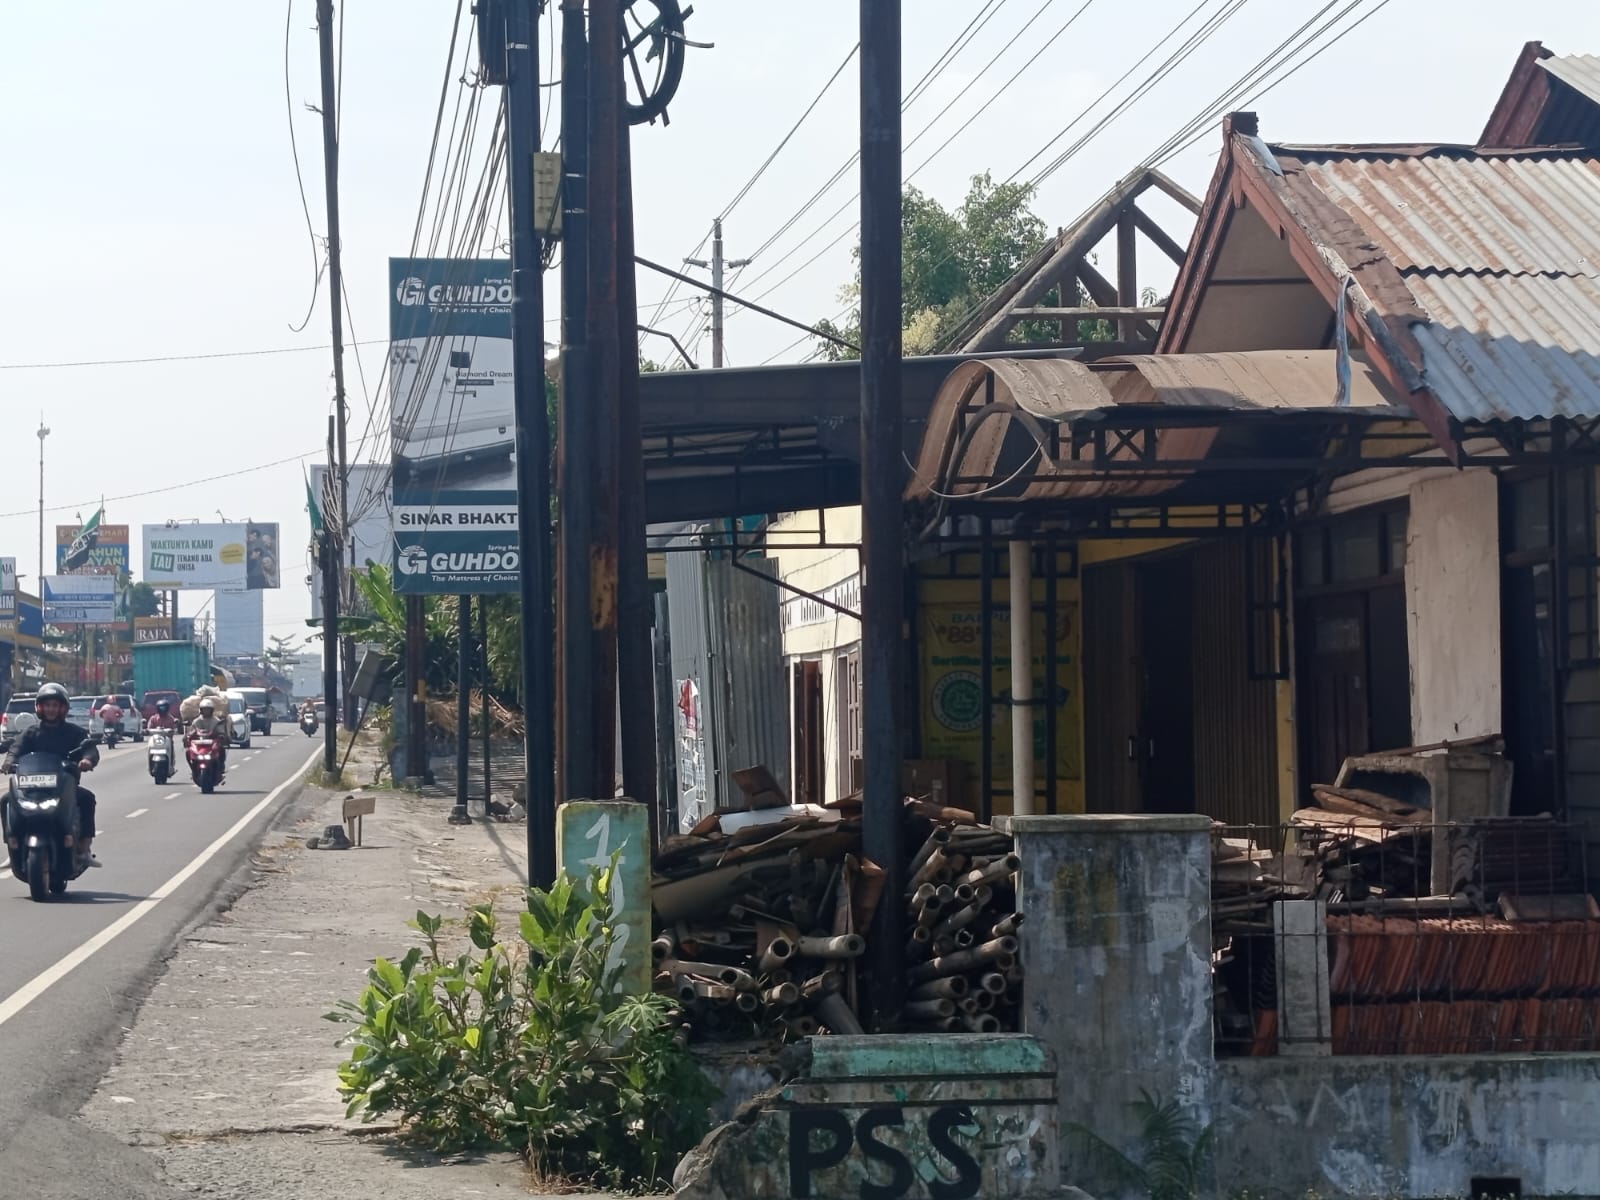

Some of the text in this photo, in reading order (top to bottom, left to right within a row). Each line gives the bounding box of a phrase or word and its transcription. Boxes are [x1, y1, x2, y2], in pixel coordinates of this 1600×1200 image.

[400, 512, 518, 525] SINAR BHAKT
[192, 539, 214, 549] KAMU
[153, 554, 172, 569] TAU
[431, 552, 519, 570] GUHDO
[483, 574, 491, 582] of
[789, 1101, 982, 1200] PSS
